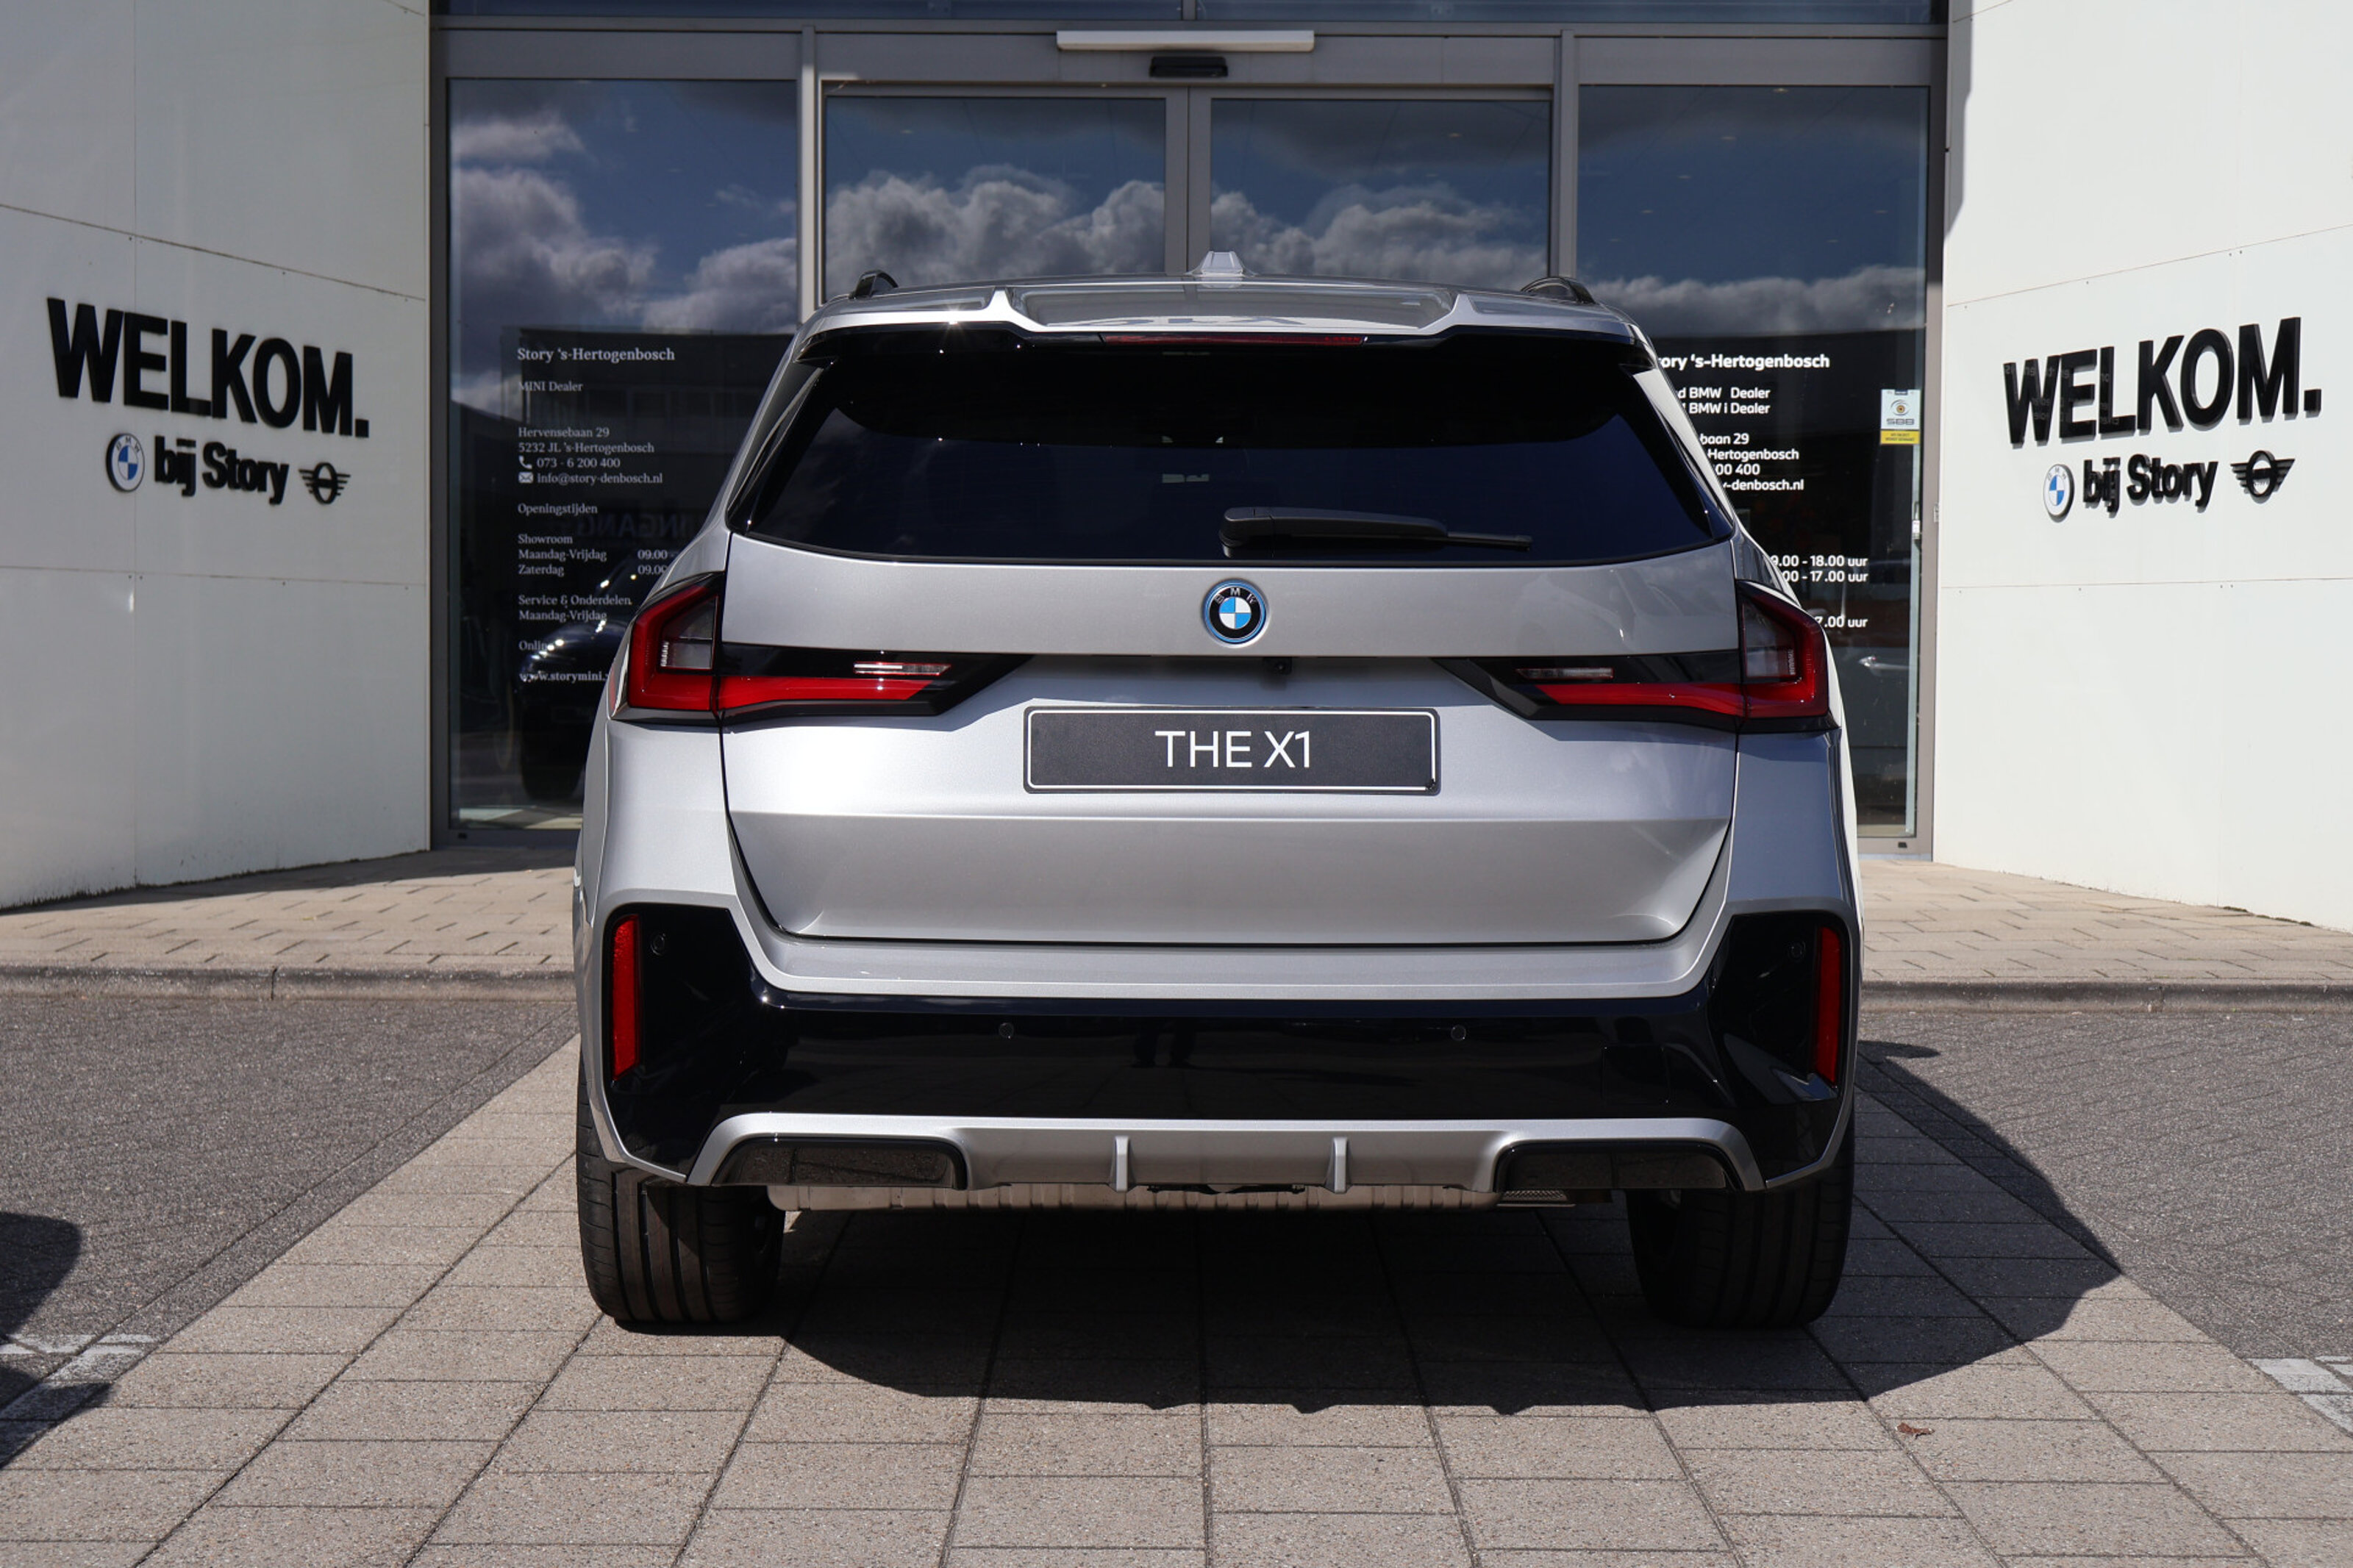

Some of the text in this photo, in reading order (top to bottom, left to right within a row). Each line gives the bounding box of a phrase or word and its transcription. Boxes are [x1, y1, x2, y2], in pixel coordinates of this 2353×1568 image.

[517, 347, 553, 363] Story
[46, 297, 369, 439] WELKOM.
[1659, 354, 1688, 371] ory
[518, 380, 583, 392] MINI Dealer
[2003, 316, 2322, 447] WELKOM.
[1689, 387, 1722, 399] BMW
[1730, 387, 1771, 400] Dealer
[1689, 402, 1722, 415] BMW
[1724, 402, 1728, 414] i
[1730, 402, 1771, 415] Dealer
[518, 426, 610, 438] Hervensebaan 29
[1700, 432, 1749, 445] baan 29
[518, 442, 545, 453] 5232
[548, 442, 561, 453] JL
[1707, 448, 1799, 462] Hertogenbosch
[537, 457, 557, 468] 073
[567, 457, 574, 468] 6
[577, 457, 598, 468] 200
[600, 457, 621, 468] 400
[154, 435, 290, 506] bij Story
[1714, 463, 1760, 476] 00 400
[538, 473, 663, 485] info@story-denbosch.nl
[2083, 454, 2218, 515] bij Story
[518, 503, 598, 516] Openingstijden
[518, 534, 573, 545] Showroom
[518, 549, 607, 562] Maandag-Vrijdag
[638, 549, 668, 560] 09.00
[1771, 554, 1799, 568] 9.00
[1810, 554, 1846, 568] 18.00
[1847, 558, 1868, 568] uur
[518, 565, 565, 577] Zaterdag
[1783, 570, 1799, 583] 00
[1847, 573, 1868, 582] uur
[518, 595, 558, 605] Service
[560, 595, 568, 606] &
[518, 610, 607, 623] Maandag-Vrijdag
[1815, 615, 1868, 628] 7.00 uur
[518, 640, 554, 651] Onlin
[519, 670, 609, 684] www.storymini.
[1154, 731, 1310, 768] THE X1
